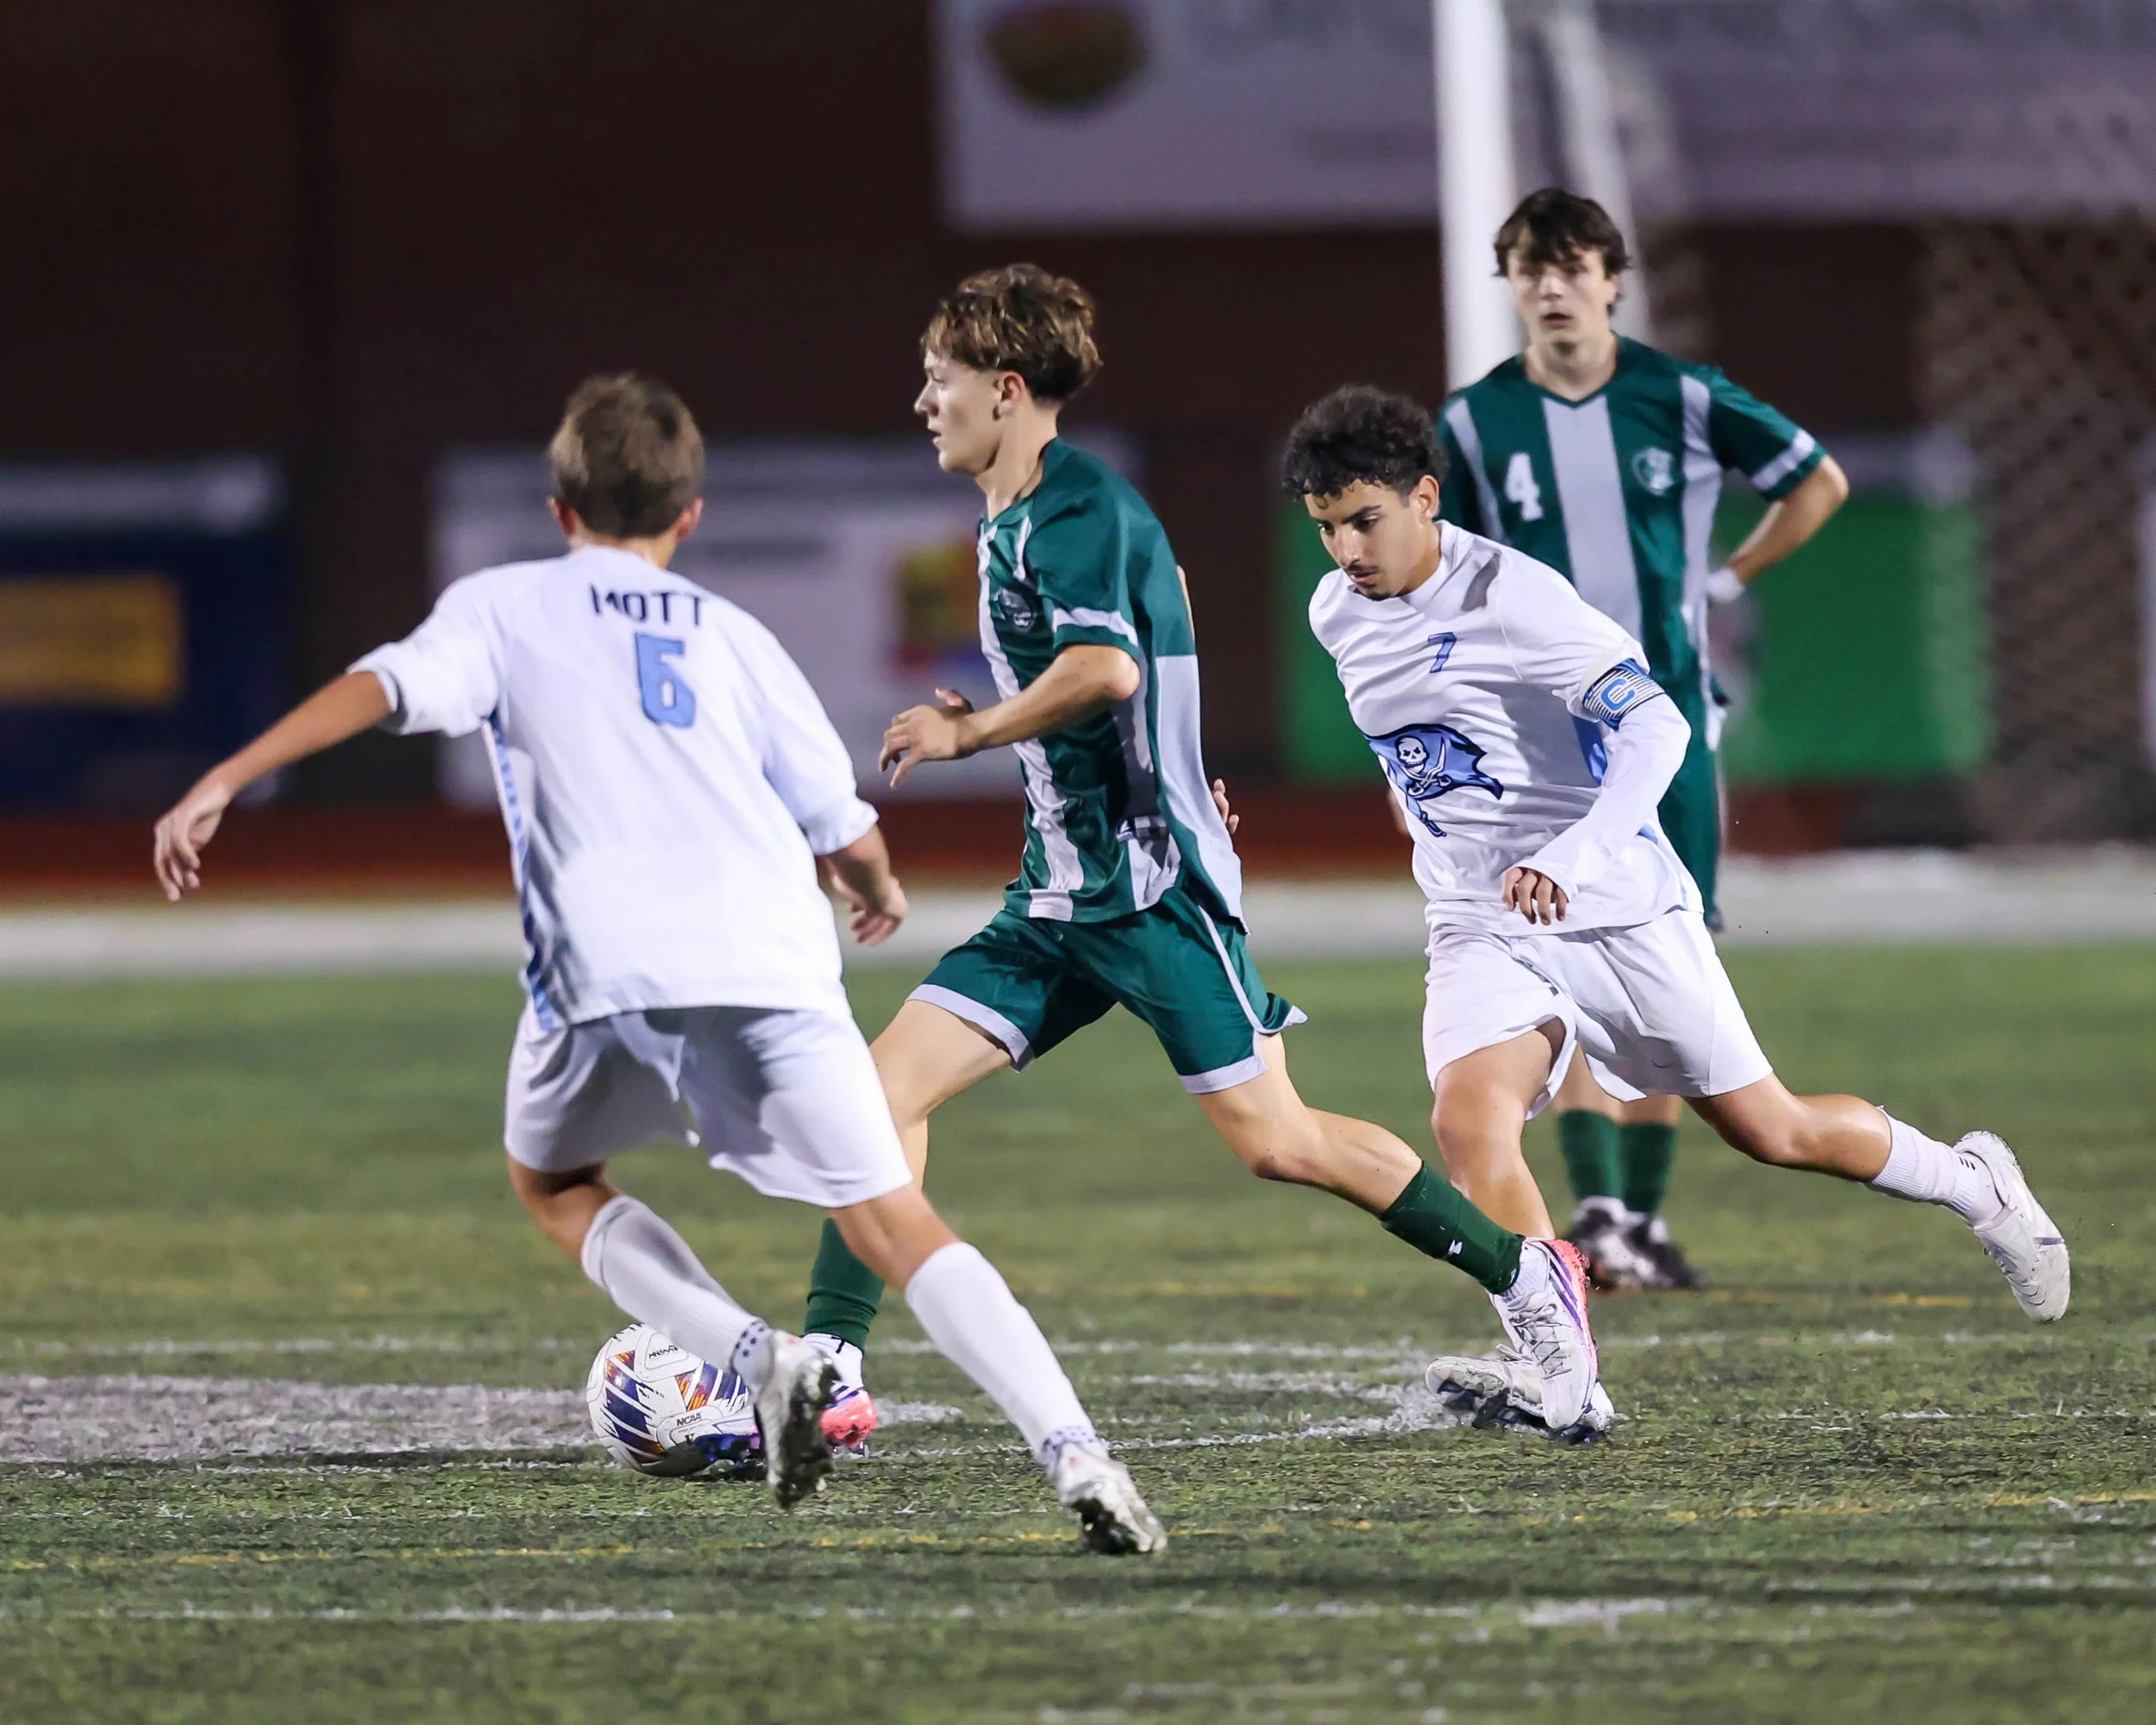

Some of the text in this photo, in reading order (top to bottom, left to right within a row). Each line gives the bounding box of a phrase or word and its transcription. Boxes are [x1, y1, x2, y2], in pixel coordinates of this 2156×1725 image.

[1505, 452, 1543, 521] 4
[1427, 631, 1457, 674] 7
[634, 632, 696, 727] 6
[1601, 677, 1636, 712] C
[676, 1412, 702, 1427] NCAA
